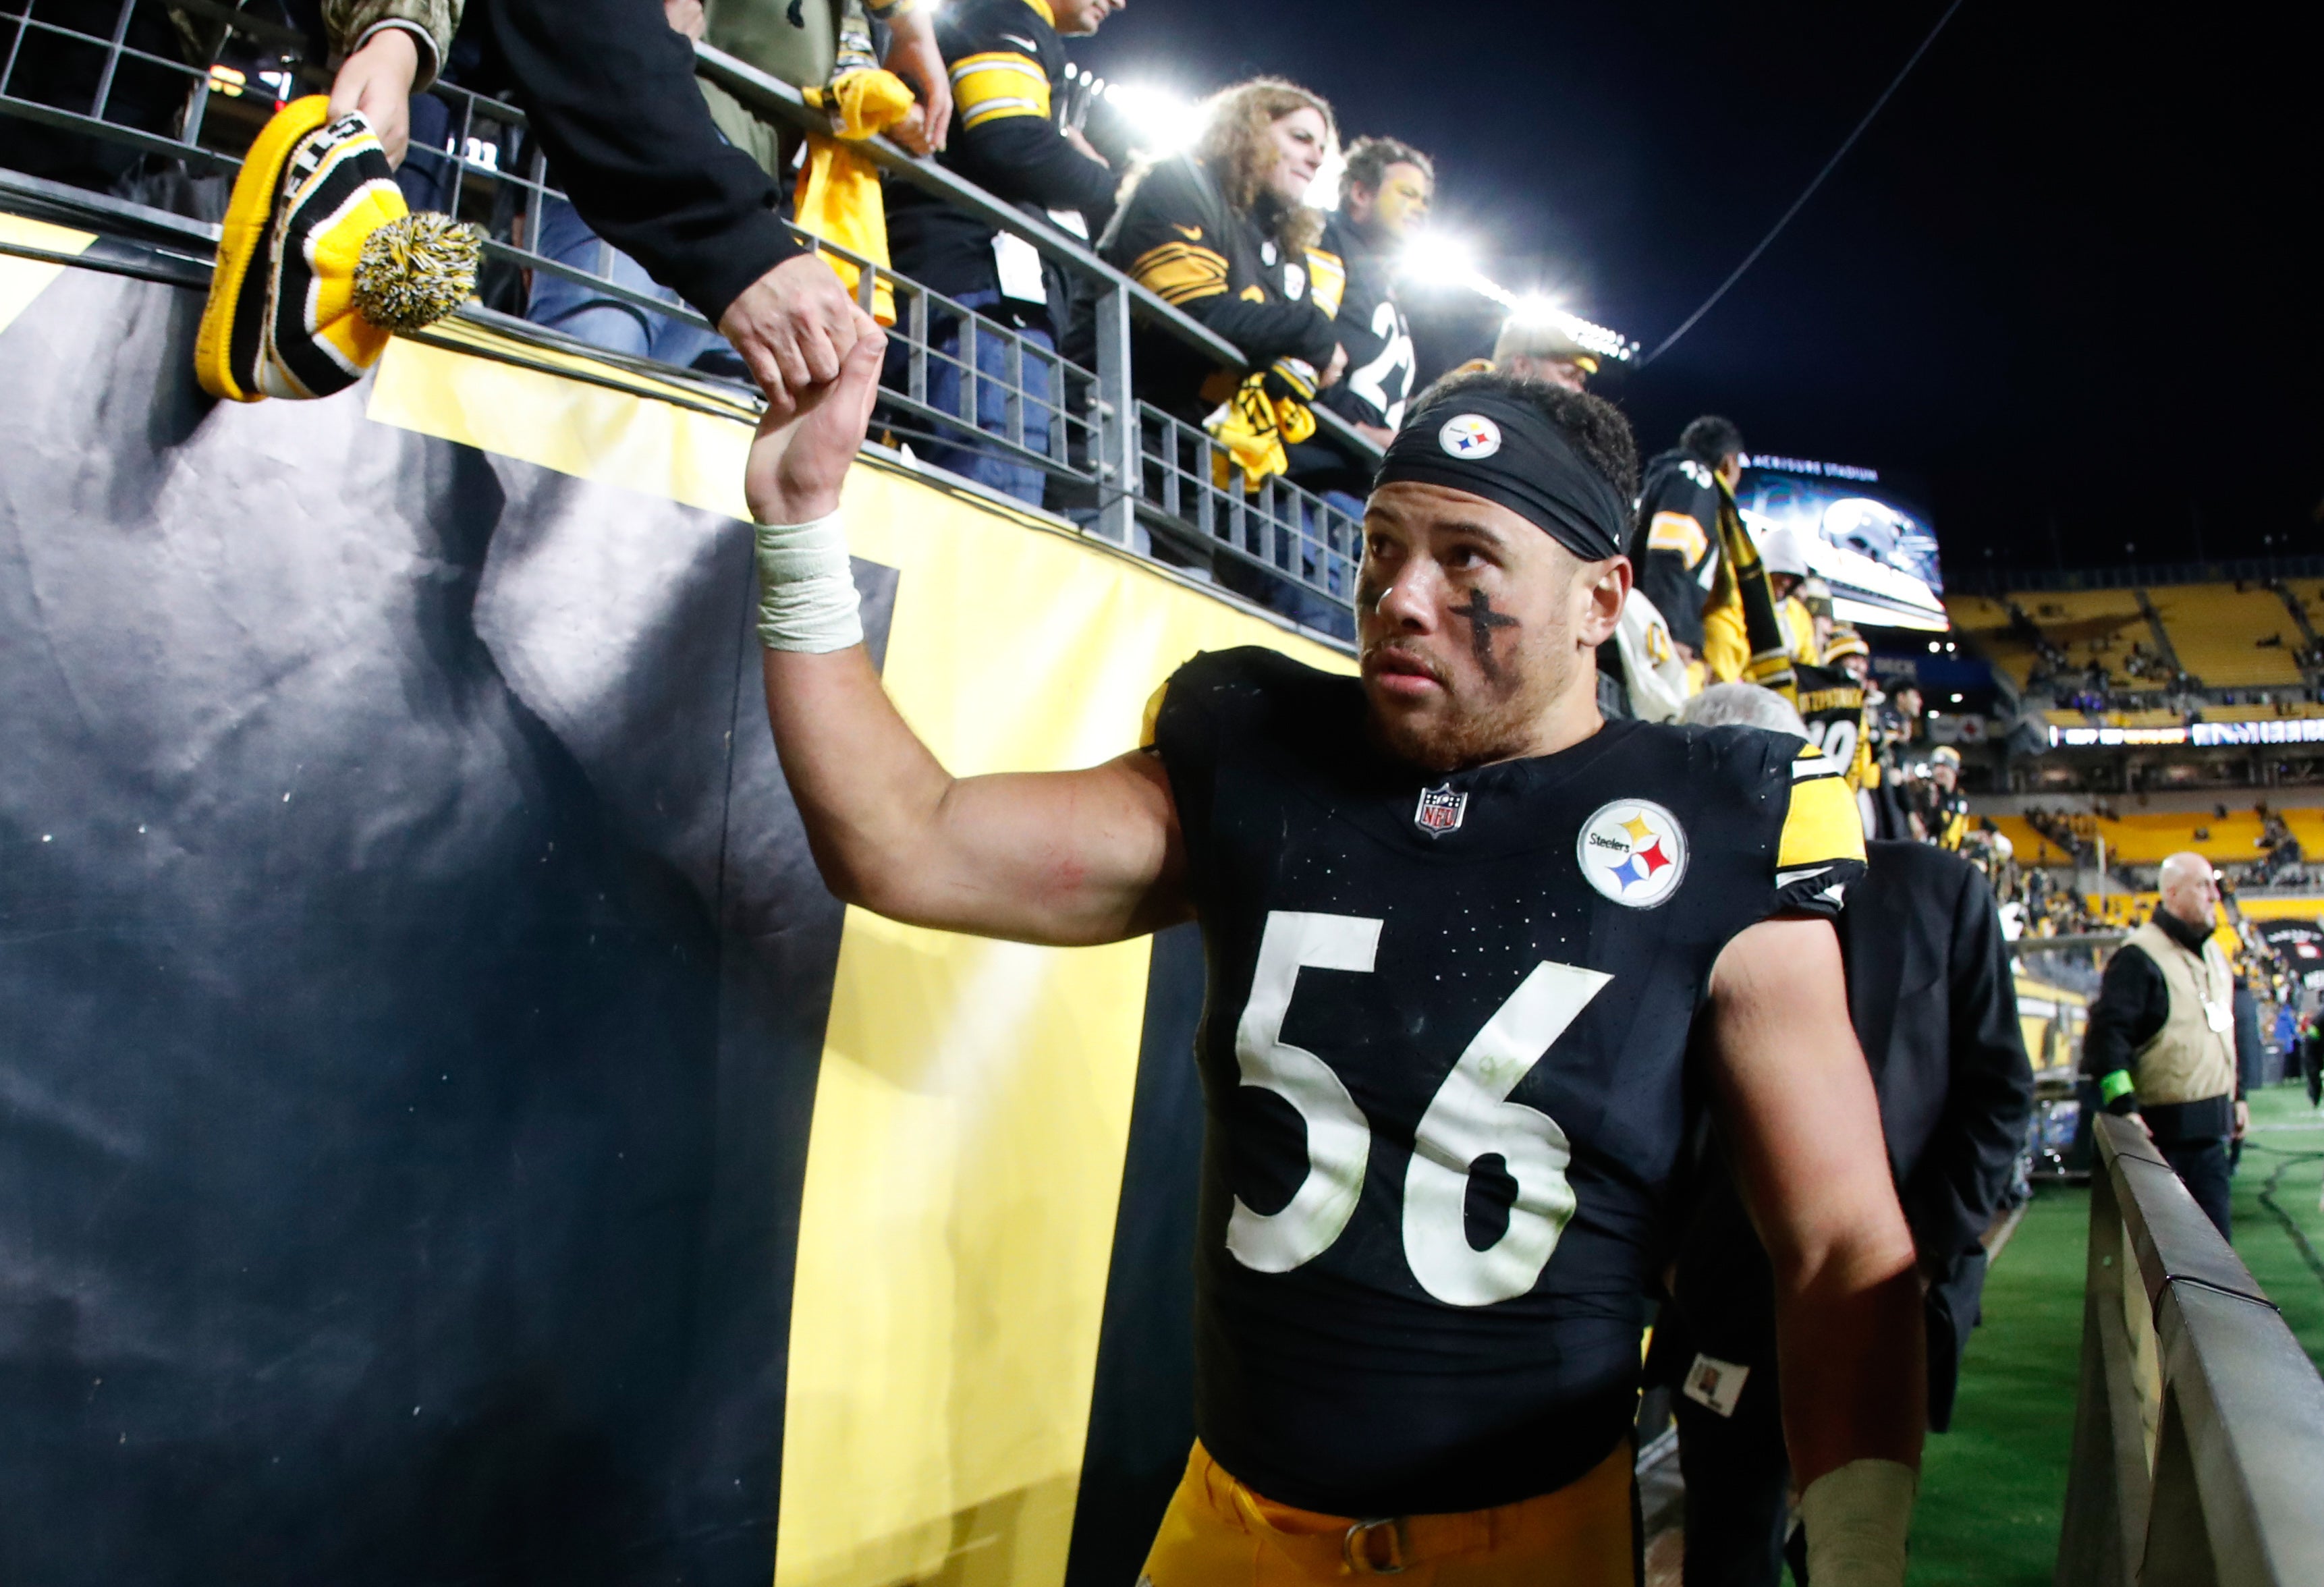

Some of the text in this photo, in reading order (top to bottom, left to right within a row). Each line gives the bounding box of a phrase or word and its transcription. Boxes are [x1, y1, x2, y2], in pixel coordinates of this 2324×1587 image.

[1423, 807, 1455, 827] NFL
[1589, 833, 1630, 853] Steelers
[1226, 910, 1615, 1306] 56
